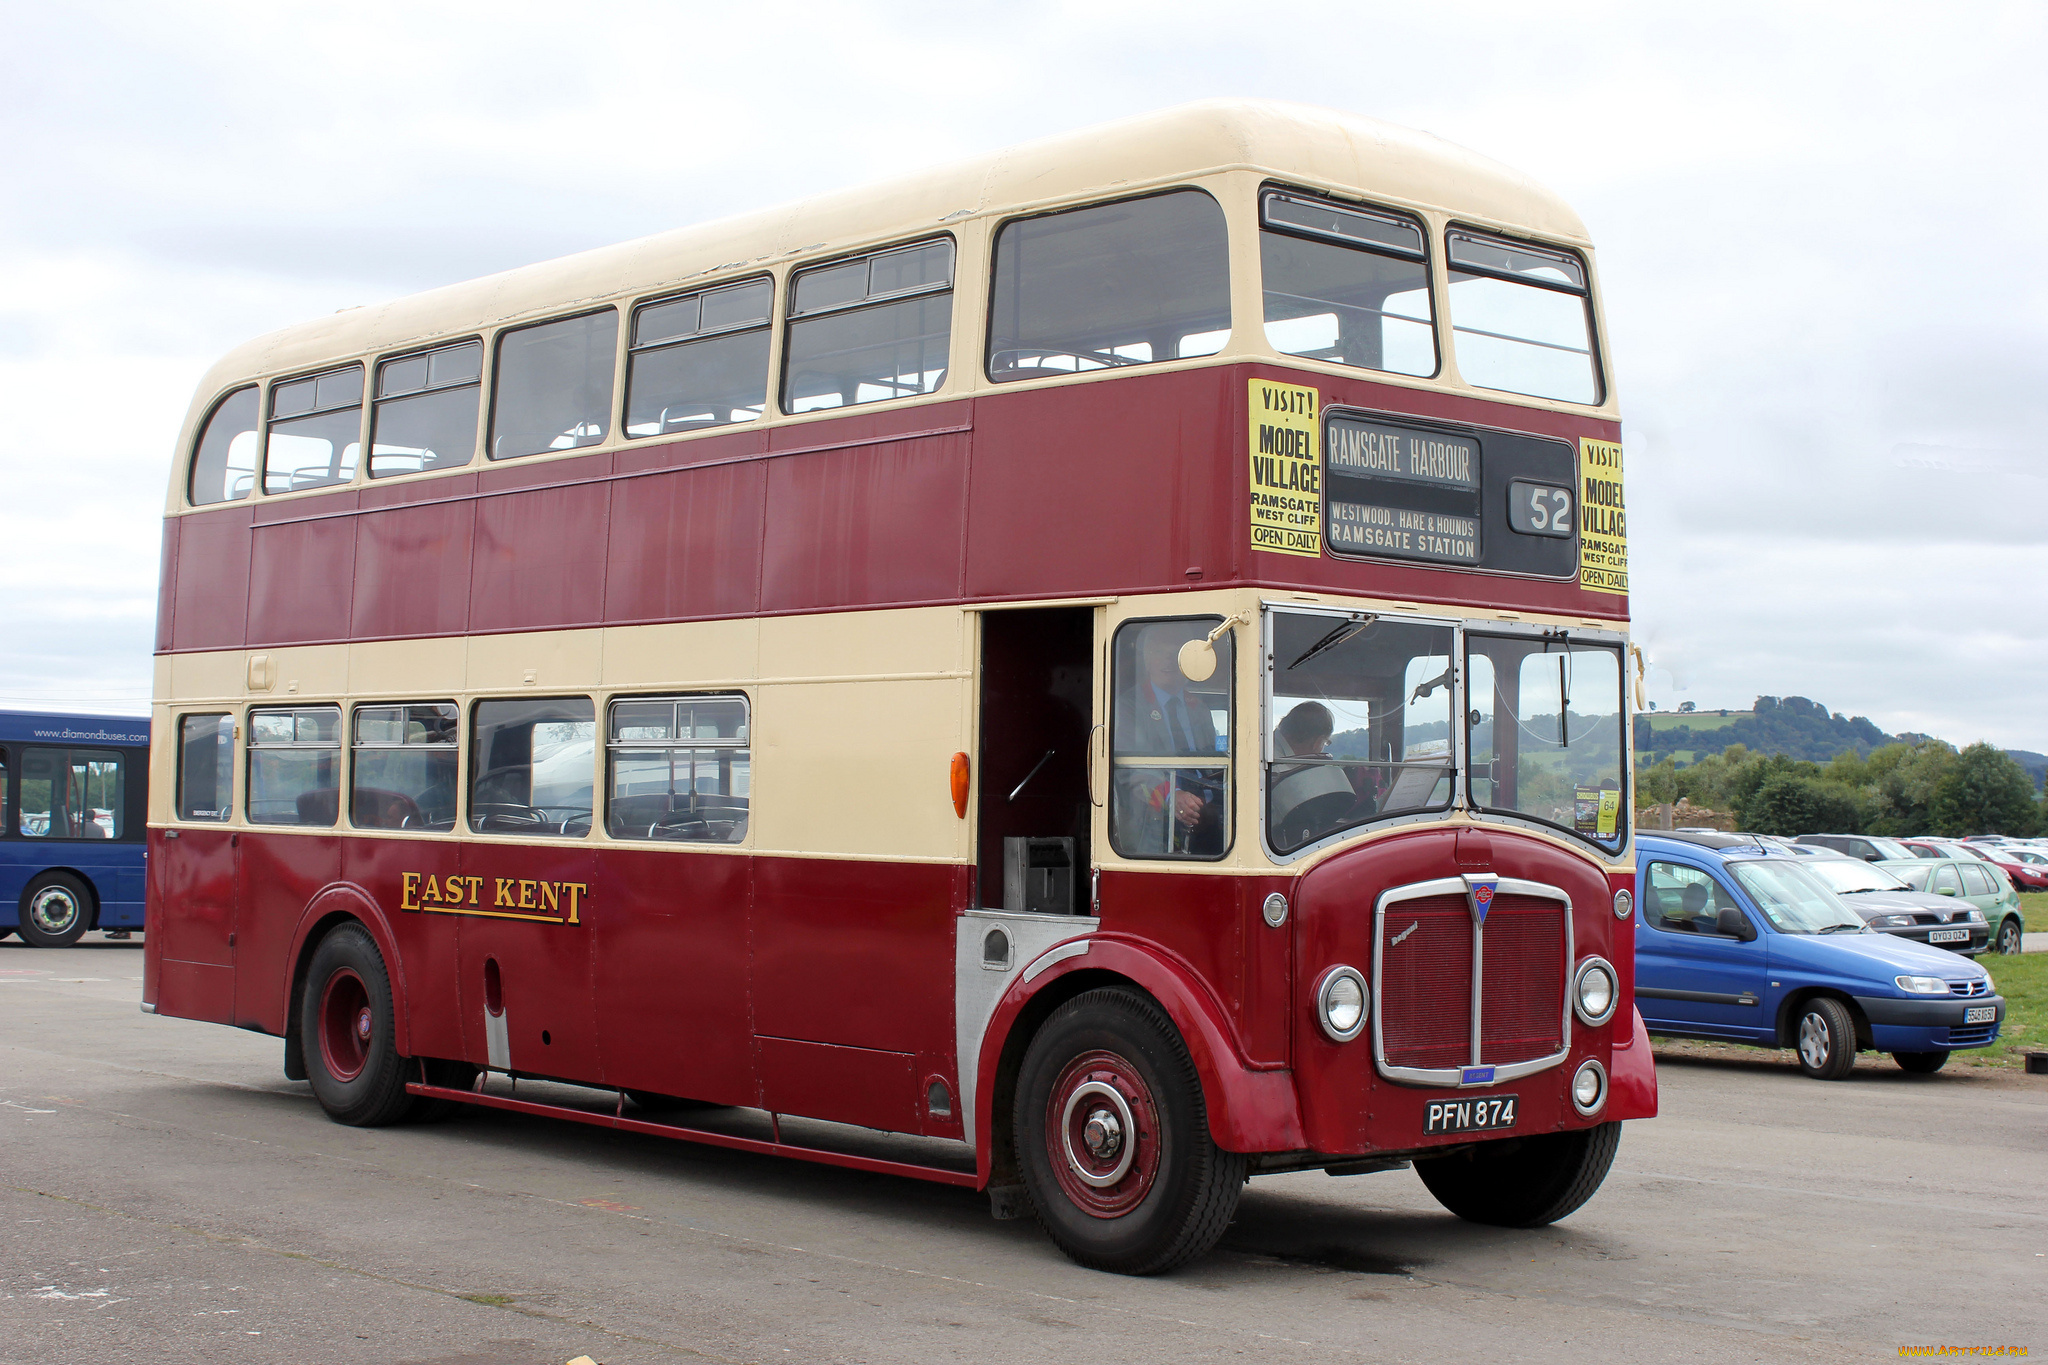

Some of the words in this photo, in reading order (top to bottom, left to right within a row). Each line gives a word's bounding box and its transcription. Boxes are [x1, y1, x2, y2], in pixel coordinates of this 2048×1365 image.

[1262, 387, 1313, 419] VISIT!
[1260, 424, 1313, 460] MODEL
[1330, 426, 1401, 472] RAMSGATE
[1410, 438, 1470, 482] HARBOUR
[1253, 456, 1319, 494] VILLAGE
[1251, 492, 1319, 514] RAMSGATE
[1586, 477, 1625, 509] MODEL
[1256, 508, 1284, 521] WEST
[1287, 513, 1316, 526] CLIFF
[1332, 501, 1395, 527] WESTWOOD,
[1400, 511, 1426, 531] HARE
[1428, 516, 1435, 532] &
[1437, 517, 1474, 537] HOUNDS
[1531, 488, 1570, 531] 52
[1254, 527, 1283, 545] OPEN
[1287, 532, 1317, 549] DAILY
[1332, 523, 1411, 550] RAMSGATE
[1418, 535, 1474, 558] STATION
[1581, 538, 1628, 556] RAMSGAT
[1584, 552, 1605, 564] WEST
[1582, 569, 1605, 584] OPEN
[1607, 573, 1628, 588] DAILY
[34, 728, 148, 741] www.diamondbuses.com
[1604, 800, 1615, 811] 64
[401, 872, 484, 912] EAST
[494, 878, 588, 925] KENT
[1476, 891, 1491, 899] AEC
[1428, 1103, 1471, 1131] PFN
[1475, 1099, 1514, 1127] 874
